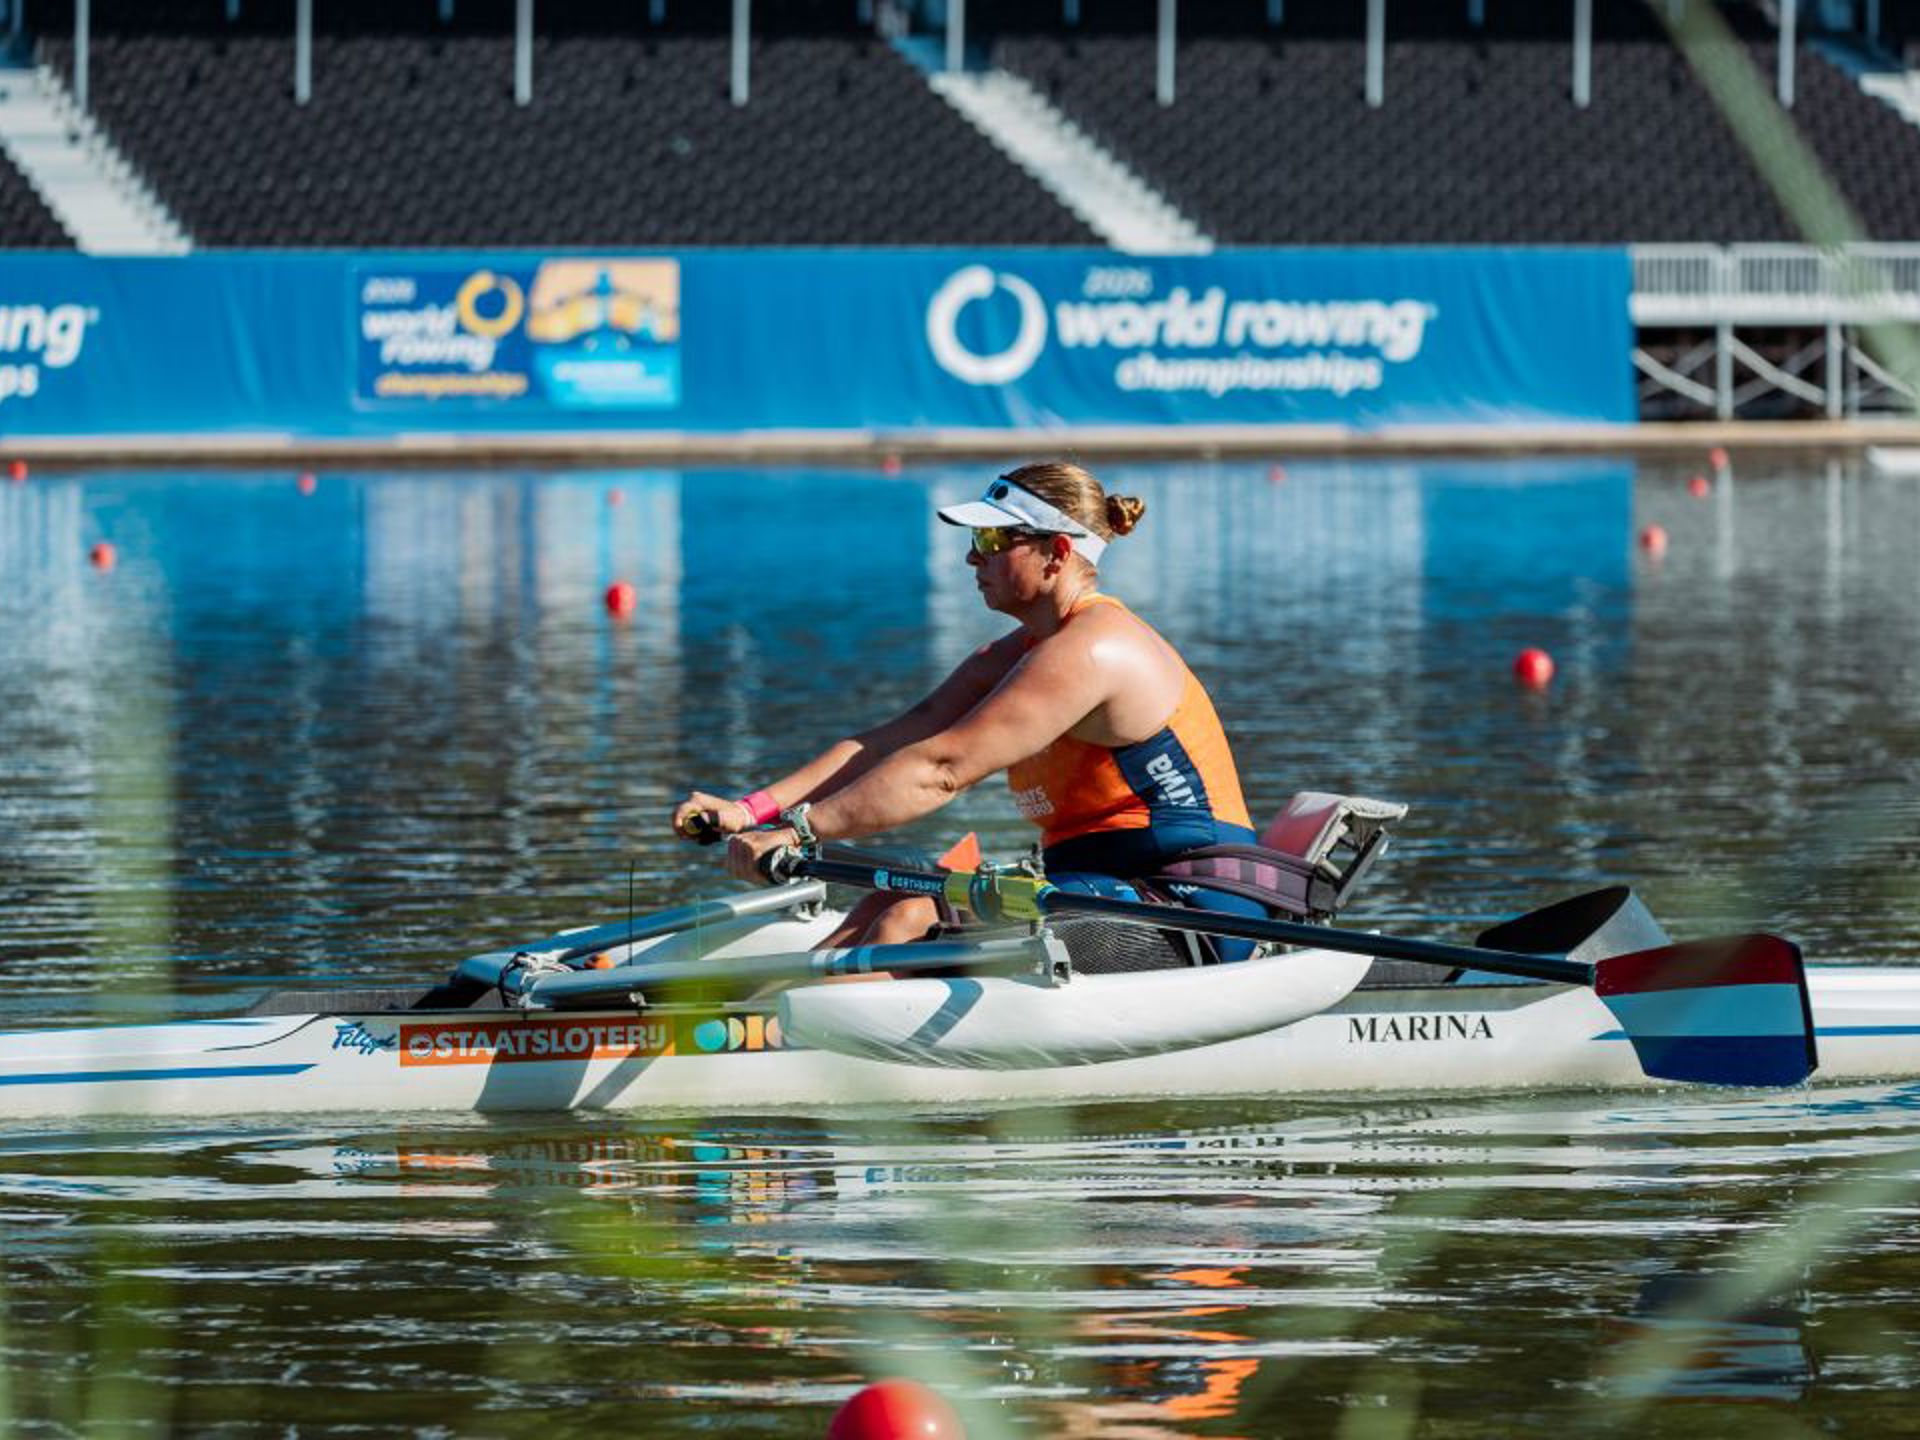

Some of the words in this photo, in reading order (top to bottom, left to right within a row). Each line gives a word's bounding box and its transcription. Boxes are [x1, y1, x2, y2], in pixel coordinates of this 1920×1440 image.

[1055, 287, 1225, 347] world
[1224, 300, 1424, 362] rowing
[1115, 351, 1383, 398] championships
[435, 1024, 667, 1057] STAATSLOTERIJ
[1348, 1014, 1494, 1043] MARINA
